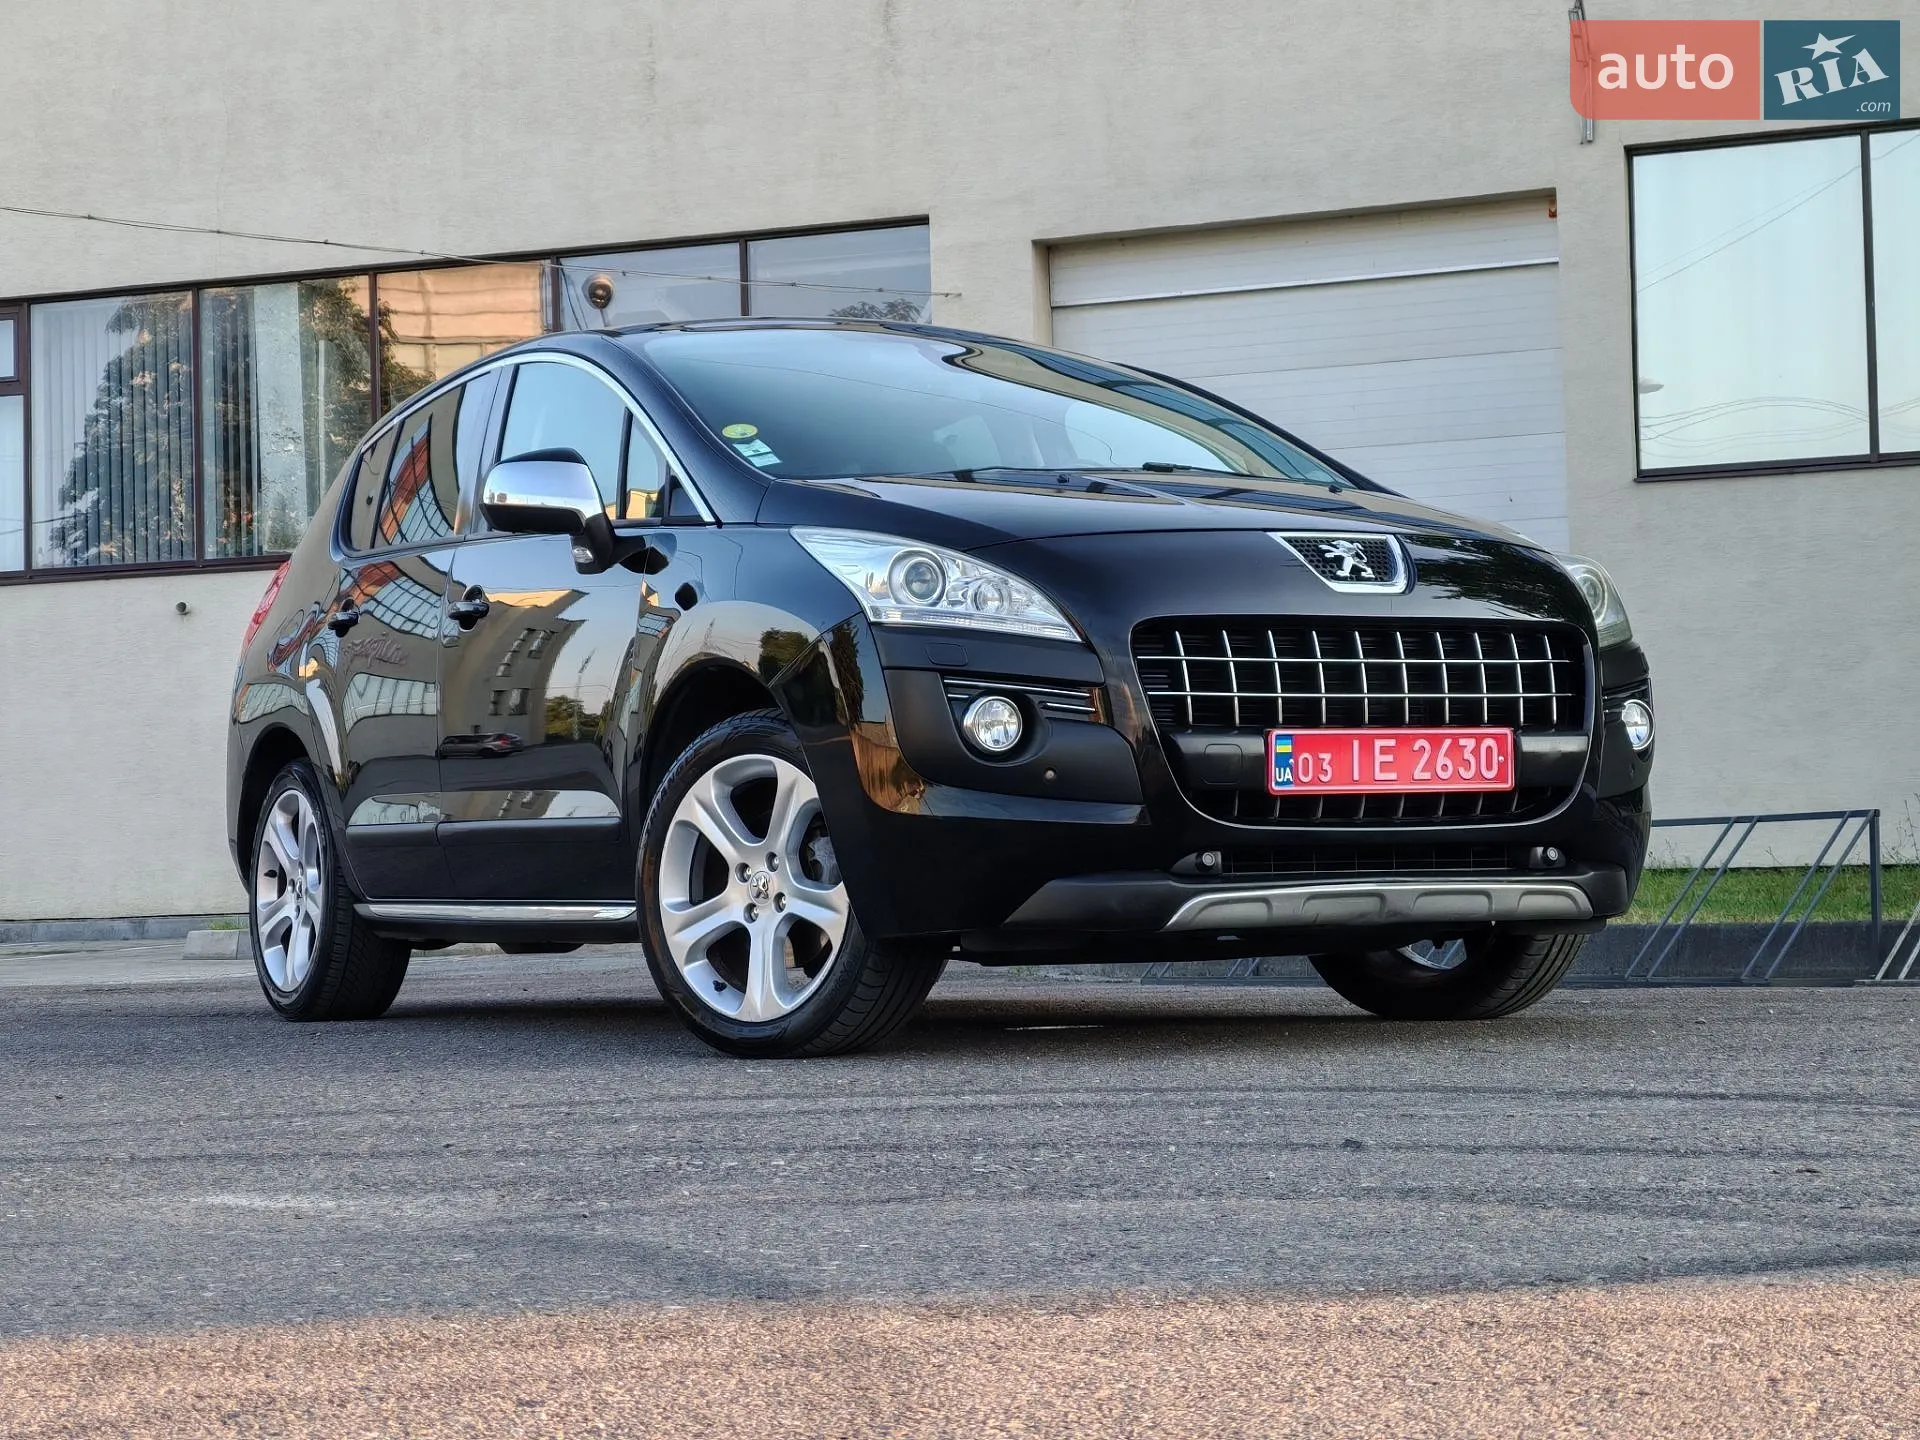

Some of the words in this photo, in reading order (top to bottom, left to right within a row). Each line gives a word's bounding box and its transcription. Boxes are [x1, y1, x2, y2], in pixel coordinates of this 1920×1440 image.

[1275, 767, 1293, 782] UA
[1298, 752, 1333, 783] 03
[1412, 737, 1499, 781] 2630
